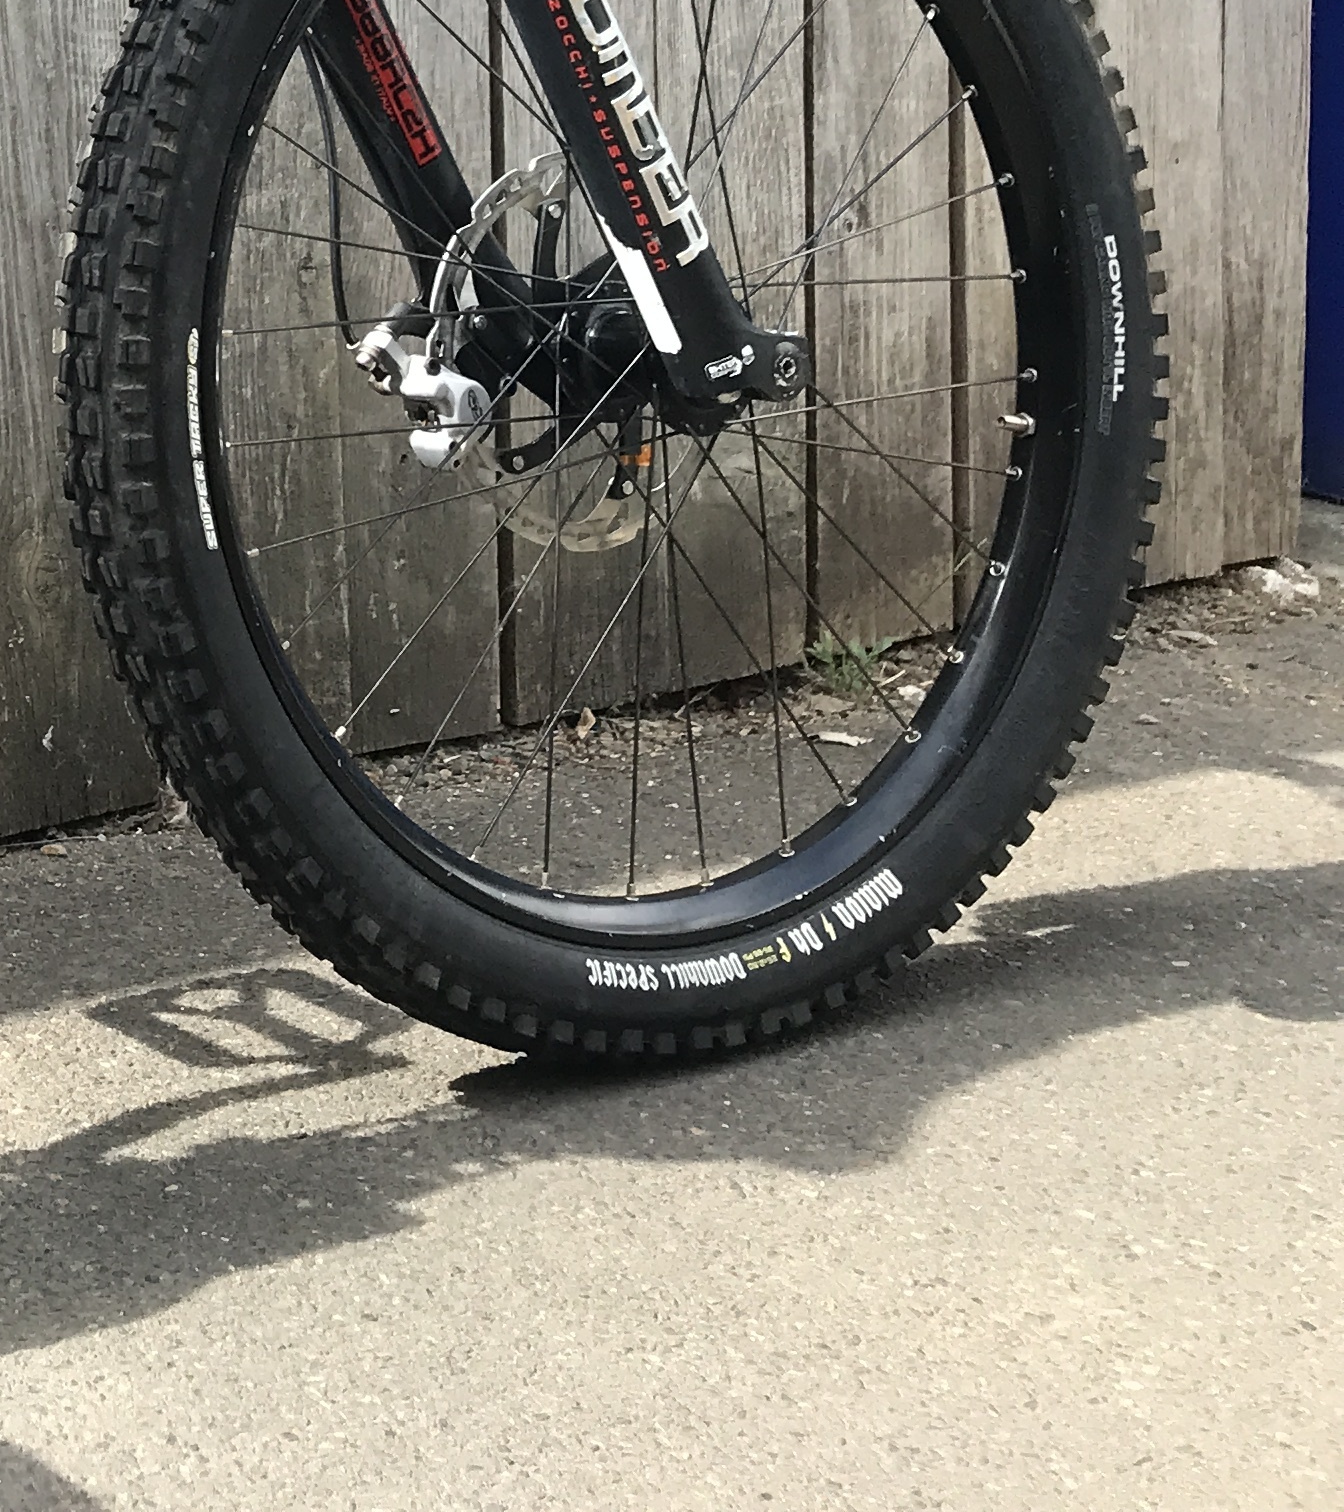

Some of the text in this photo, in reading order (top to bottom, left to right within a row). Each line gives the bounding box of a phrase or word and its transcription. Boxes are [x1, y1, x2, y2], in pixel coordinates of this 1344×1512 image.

[1104, 235, 1126, 402] DOWNHILL
[187, 364, 202, 458] TACKY
[193, 460, 218, 550] SUPER
